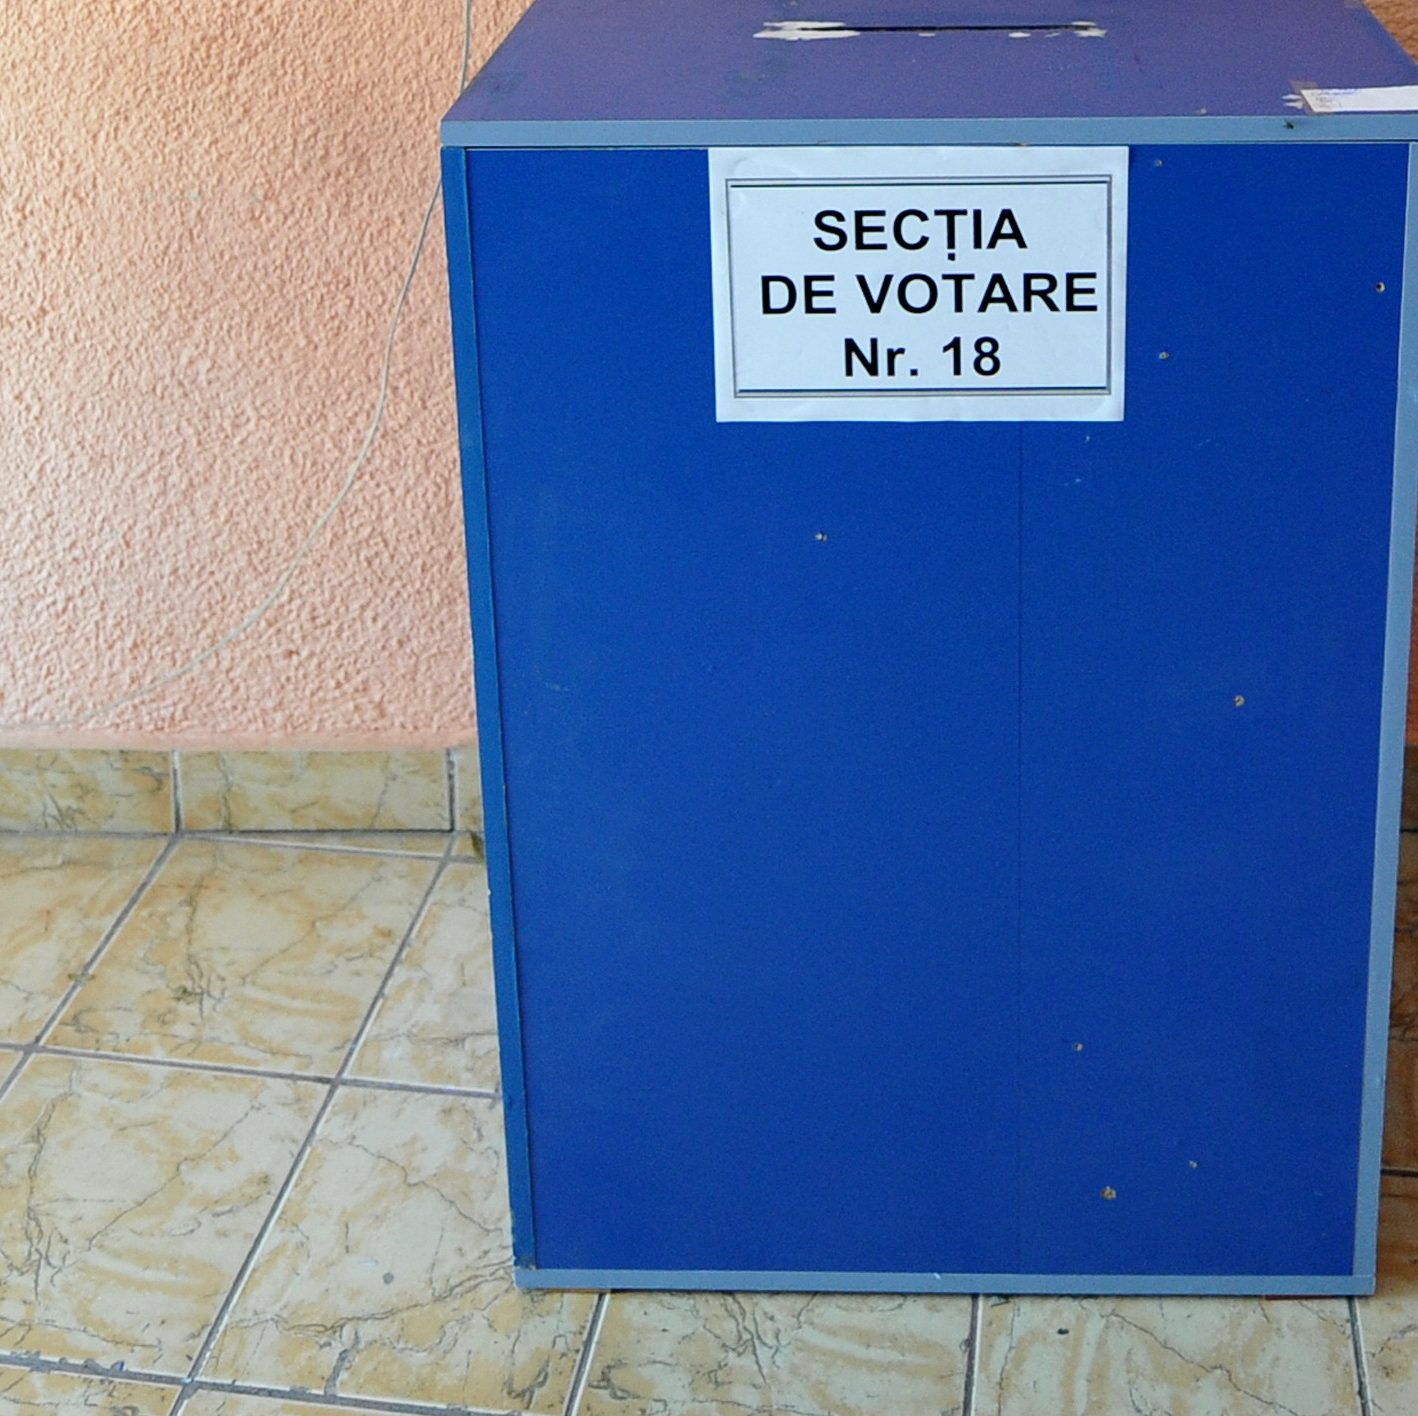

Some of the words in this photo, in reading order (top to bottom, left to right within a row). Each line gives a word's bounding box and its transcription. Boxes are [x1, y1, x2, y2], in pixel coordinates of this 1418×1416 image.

[760, 274, 837, 315] DE
[855, 271, 1098, 315] VOTARE
[844, 337, 919, 377] Nr.
[942, 336, 1001, 377] 18
